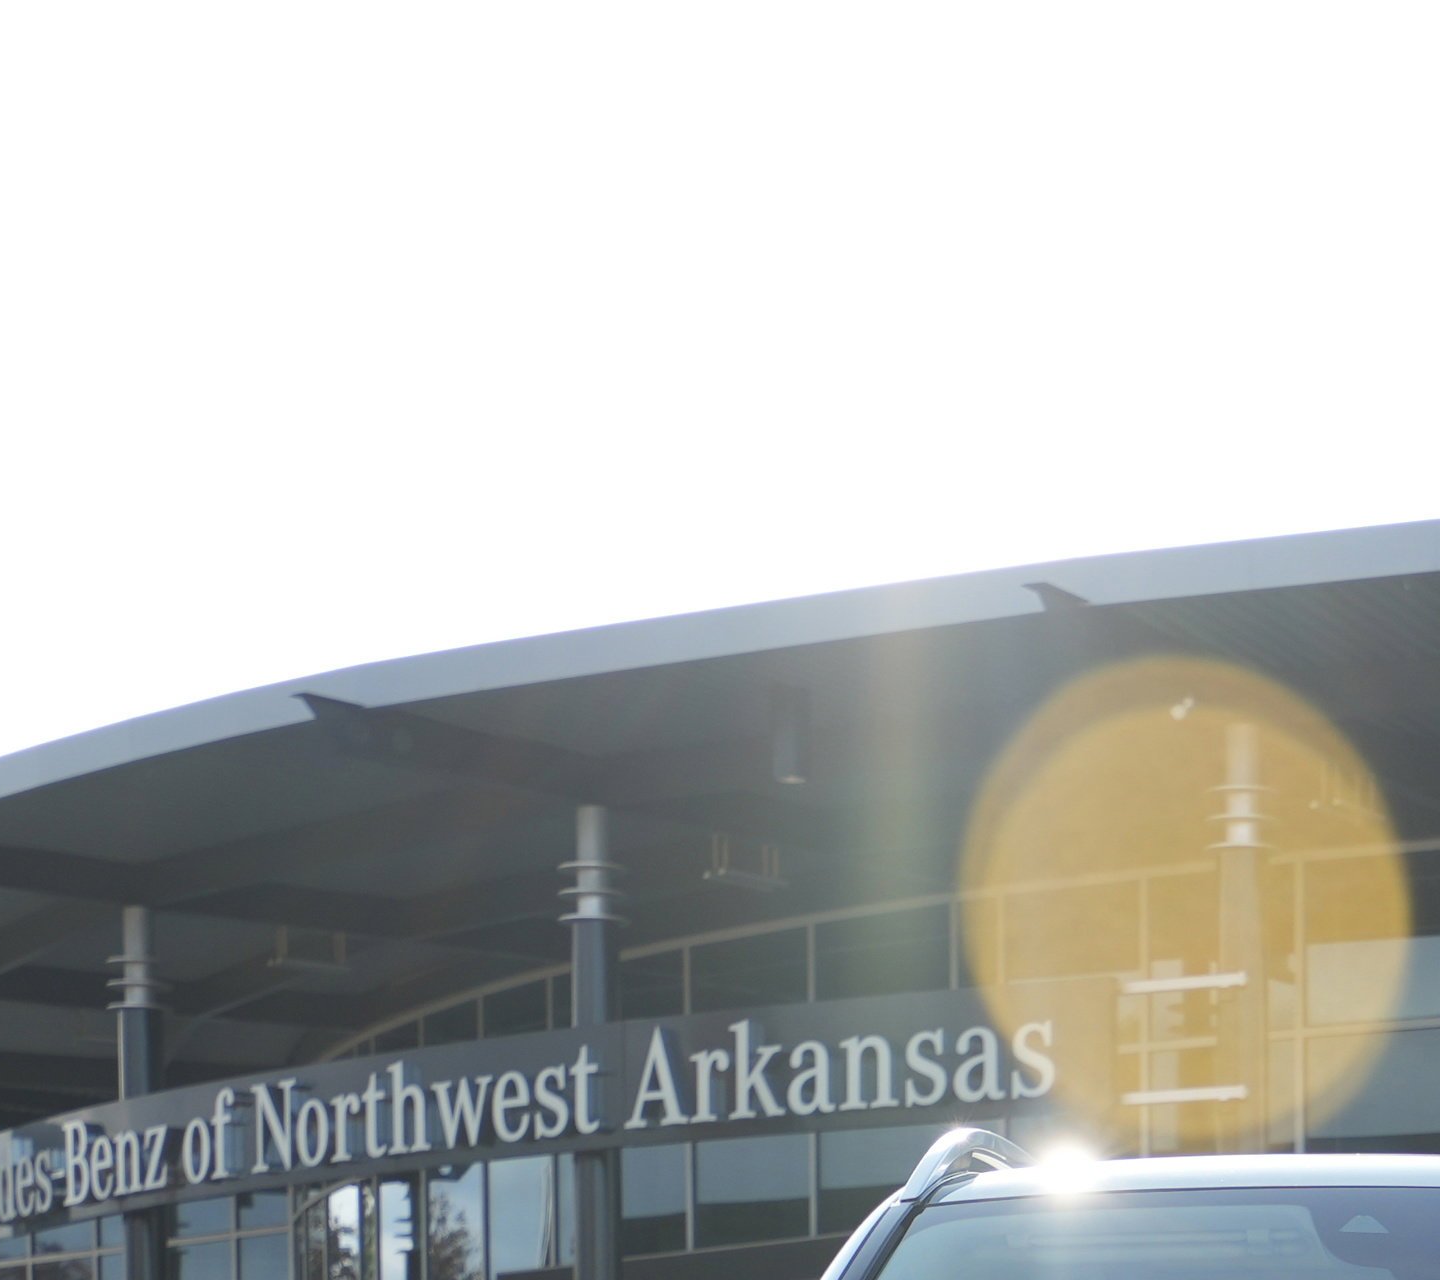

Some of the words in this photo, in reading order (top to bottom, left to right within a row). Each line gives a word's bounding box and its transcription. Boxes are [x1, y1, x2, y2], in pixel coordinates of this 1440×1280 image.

[181, 1086, 235, 1185] of
[250, 1044, 601, 1175] Northwest
[623, 1019, 1057, 1130] Arkansas
